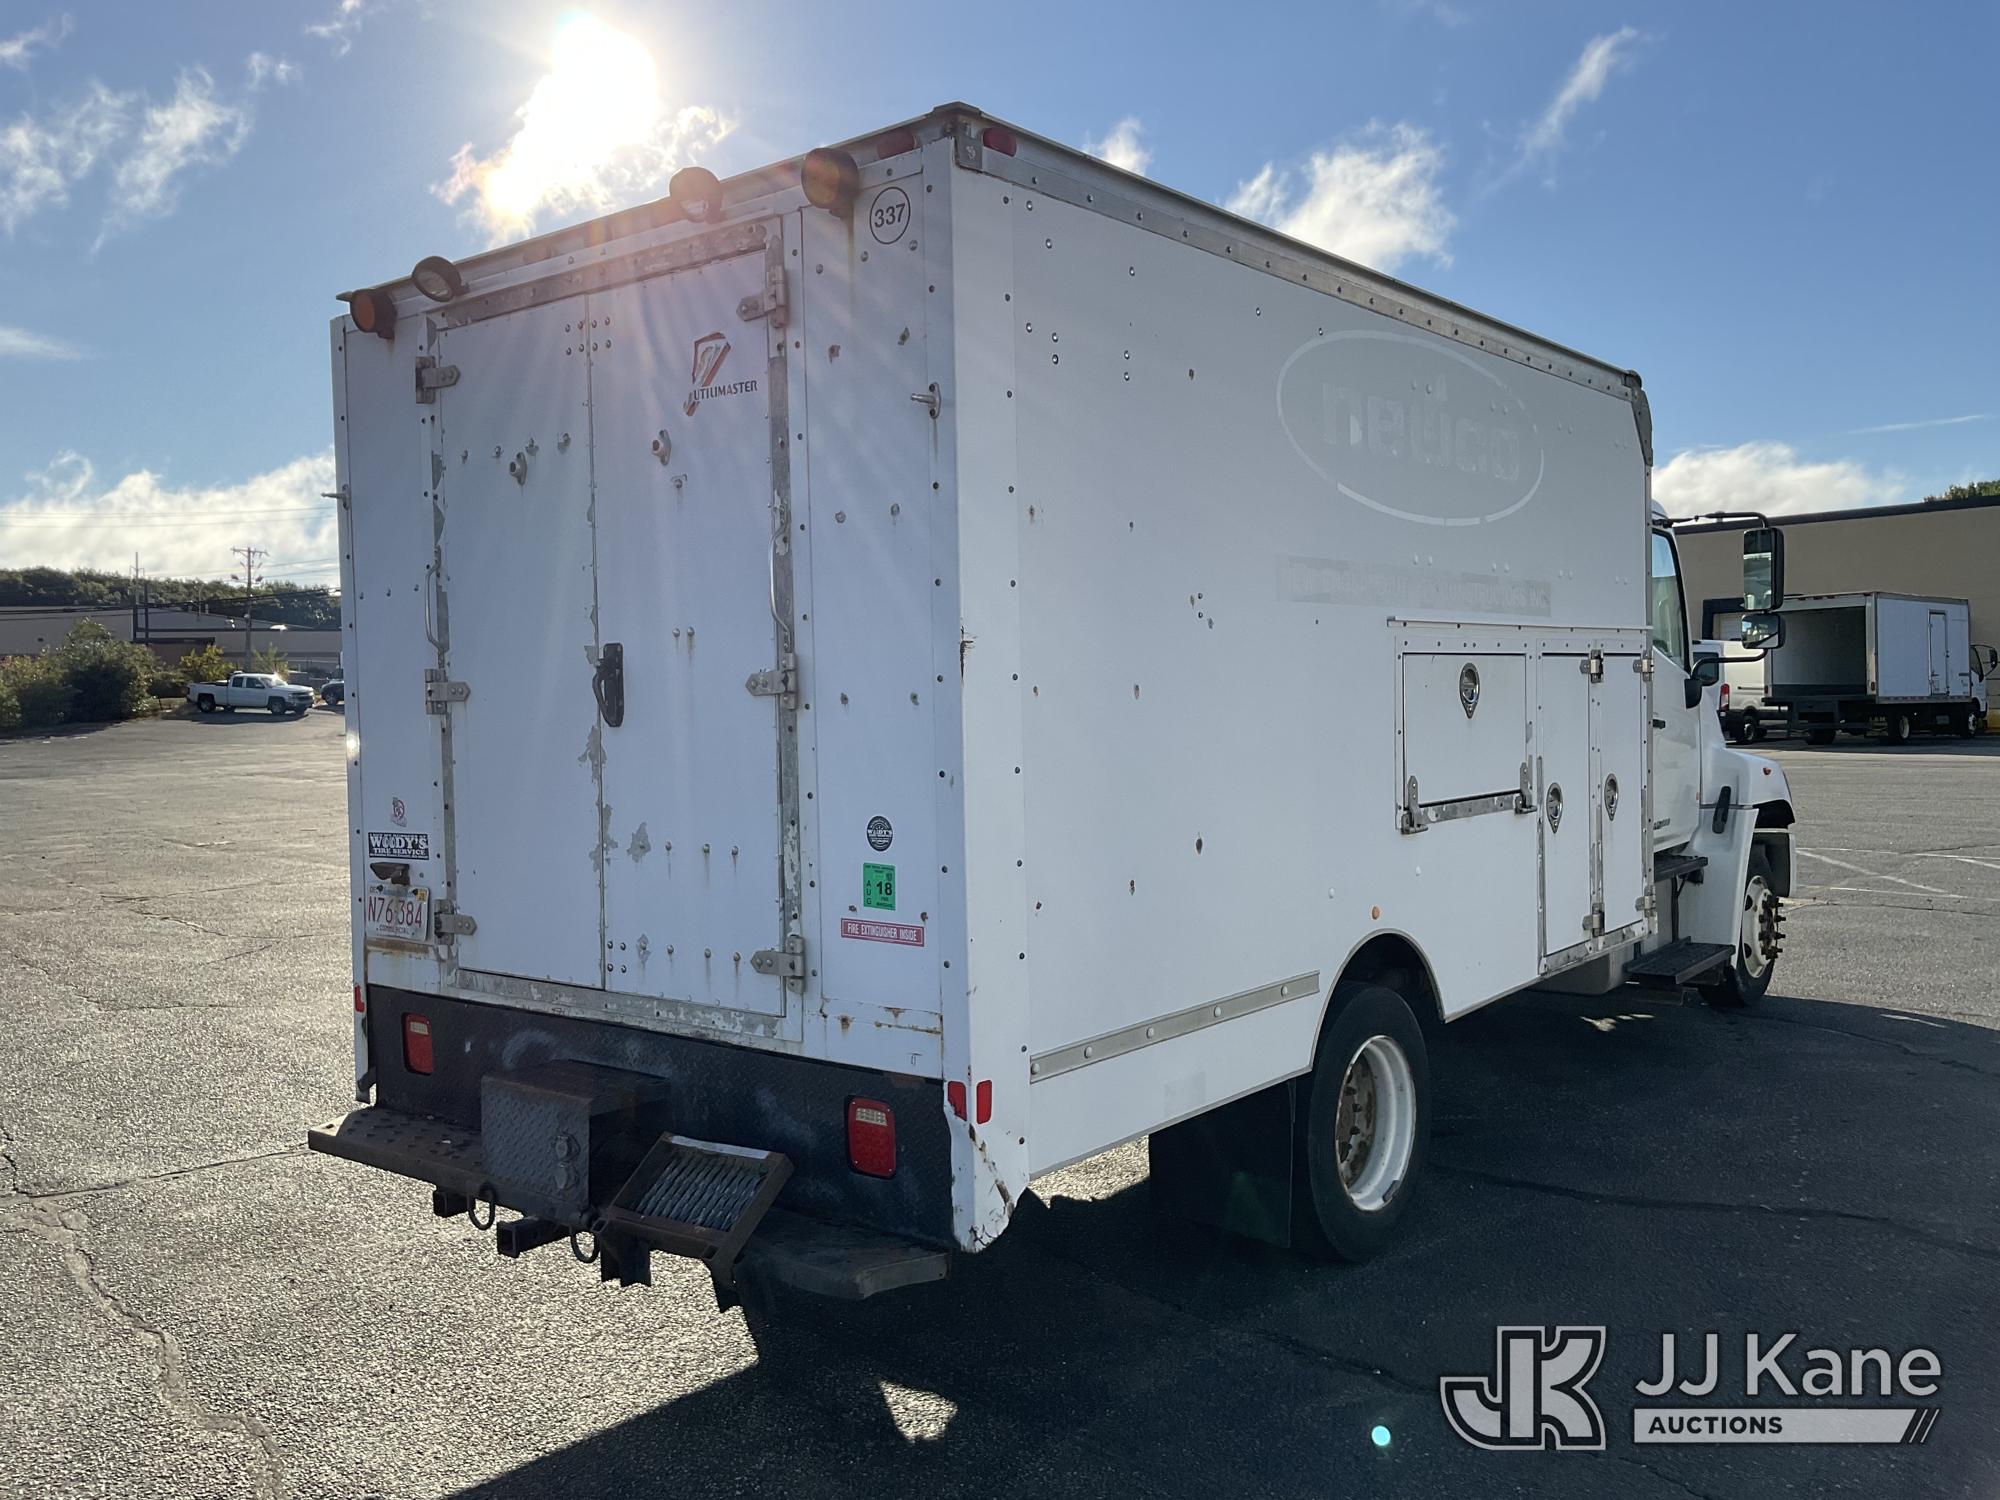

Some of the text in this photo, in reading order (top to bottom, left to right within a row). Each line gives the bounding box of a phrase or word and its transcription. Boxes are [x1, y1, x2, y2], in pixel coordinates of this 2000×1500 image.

[874, 203, 906, 228] 337
[693, 380, 758, 401] UTILIMASTER
[370, 835, 429, 850] WOODY'S
[393, 848, 426, 856] SERVICE
[876, 881, 893, 896] 18
[847, 922, 917, 941] FIRE EXTINGUISHER INSIDE
